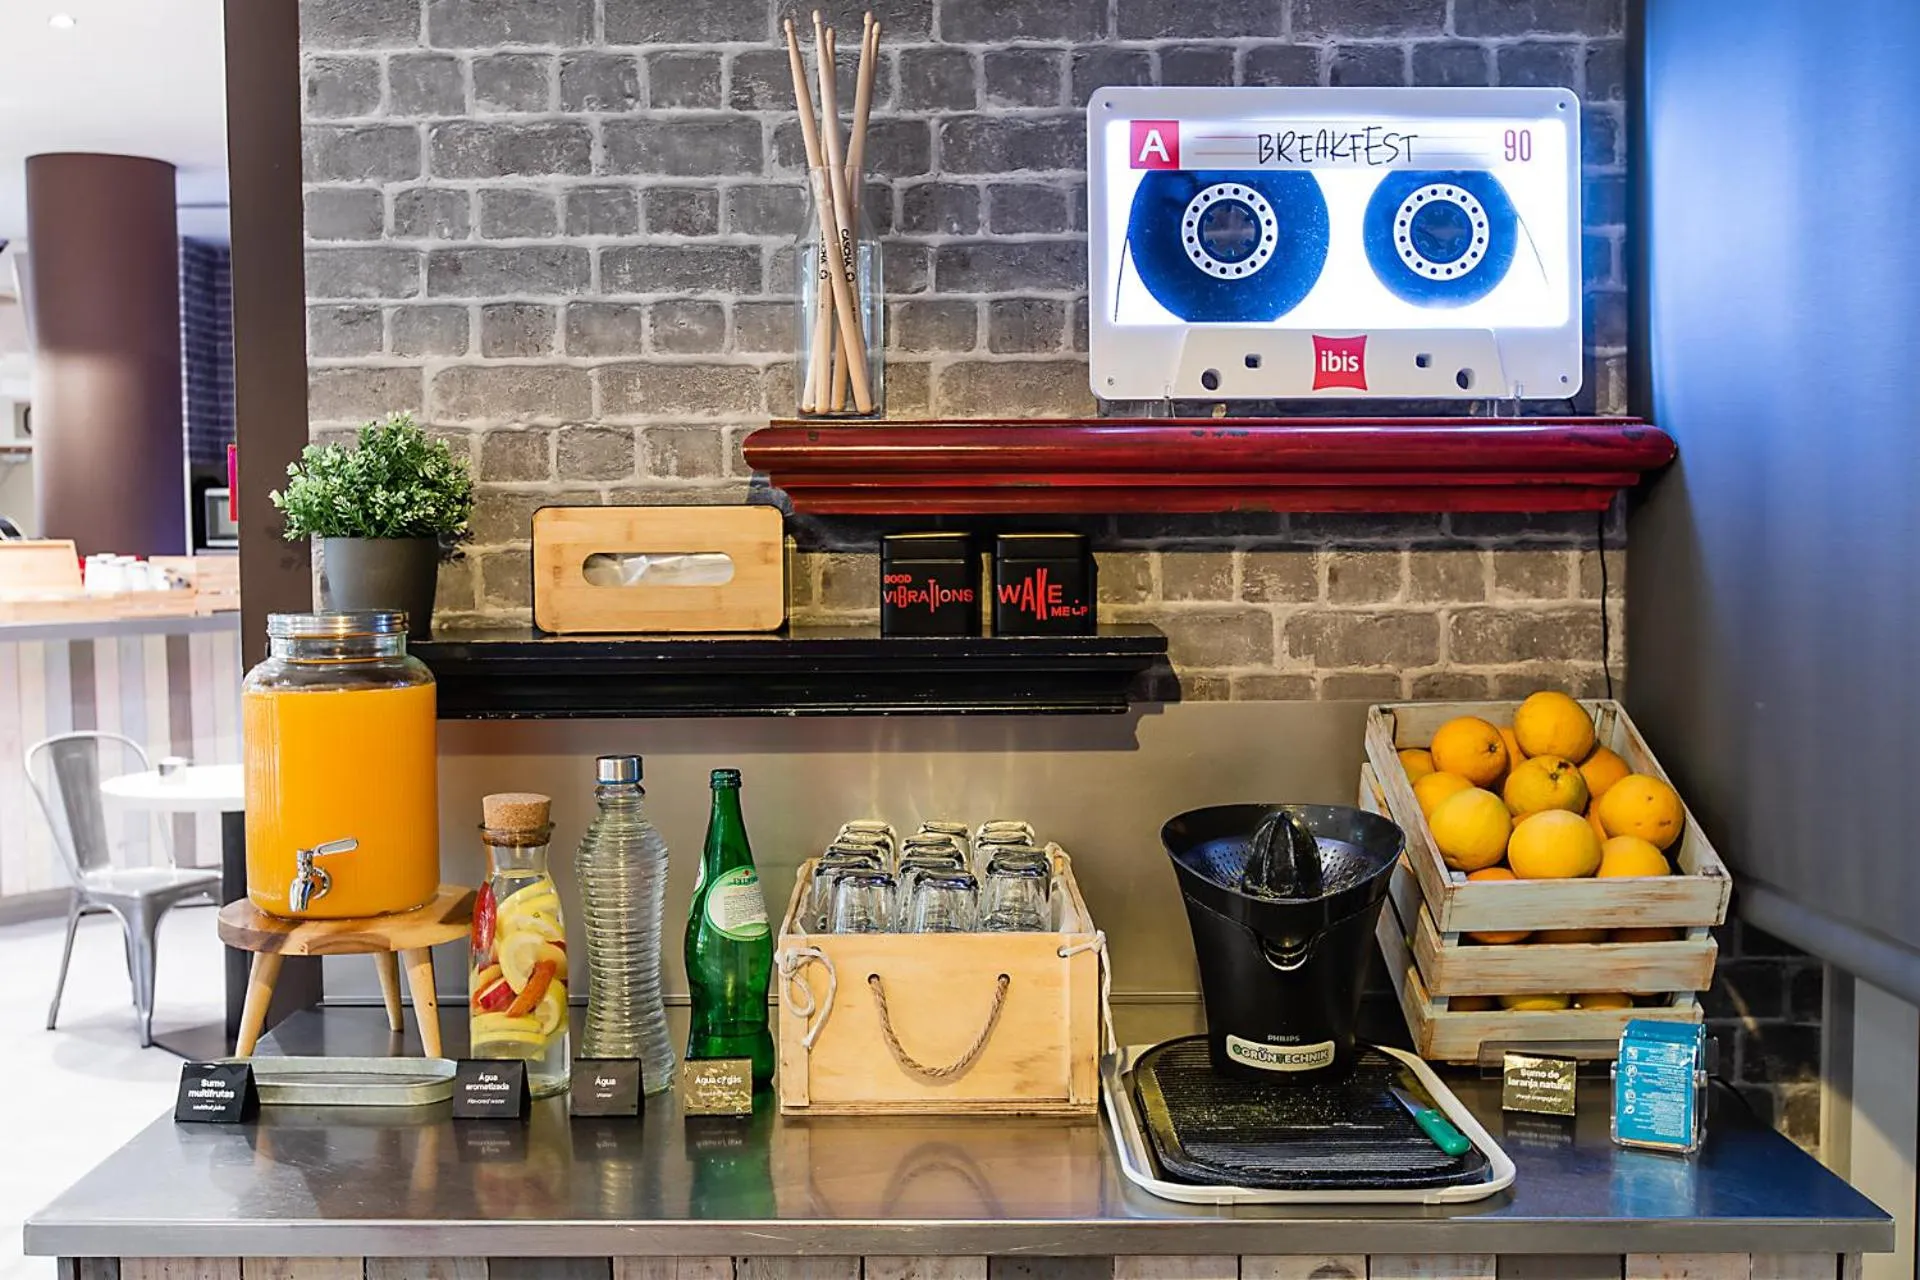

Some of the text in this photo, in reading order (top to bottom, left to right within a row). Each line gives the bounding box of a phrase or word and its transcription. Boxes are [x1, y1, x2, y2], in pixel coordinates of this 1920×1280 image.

[1139, 129, 1170, 162] A
[1258, 126, 1418, 165] BREAKFEST
[1504, 129, 1532, 162] 90
[841, 228, 853, 267] CASCHA
[1321, 349, 1359, 372] ibis
[883, 574, 912, 584] GOOD
[883, 579, 974, 613] VIBRATIONS
[997, 568, 1062, 620] WAKE
[1267, 1034, 1301, 1043] PHILIPS
[478, 1071, 498, 1083] Água
[1520, 1068, 1560, 1079] Sumo de
[200, 1078, 226, 1088] Sumo
[465, 1082, 510, 1091] aromatizada
[595, 1075, 617, 1087] Água
[188, 1088, 235, 1099] multifrutas
